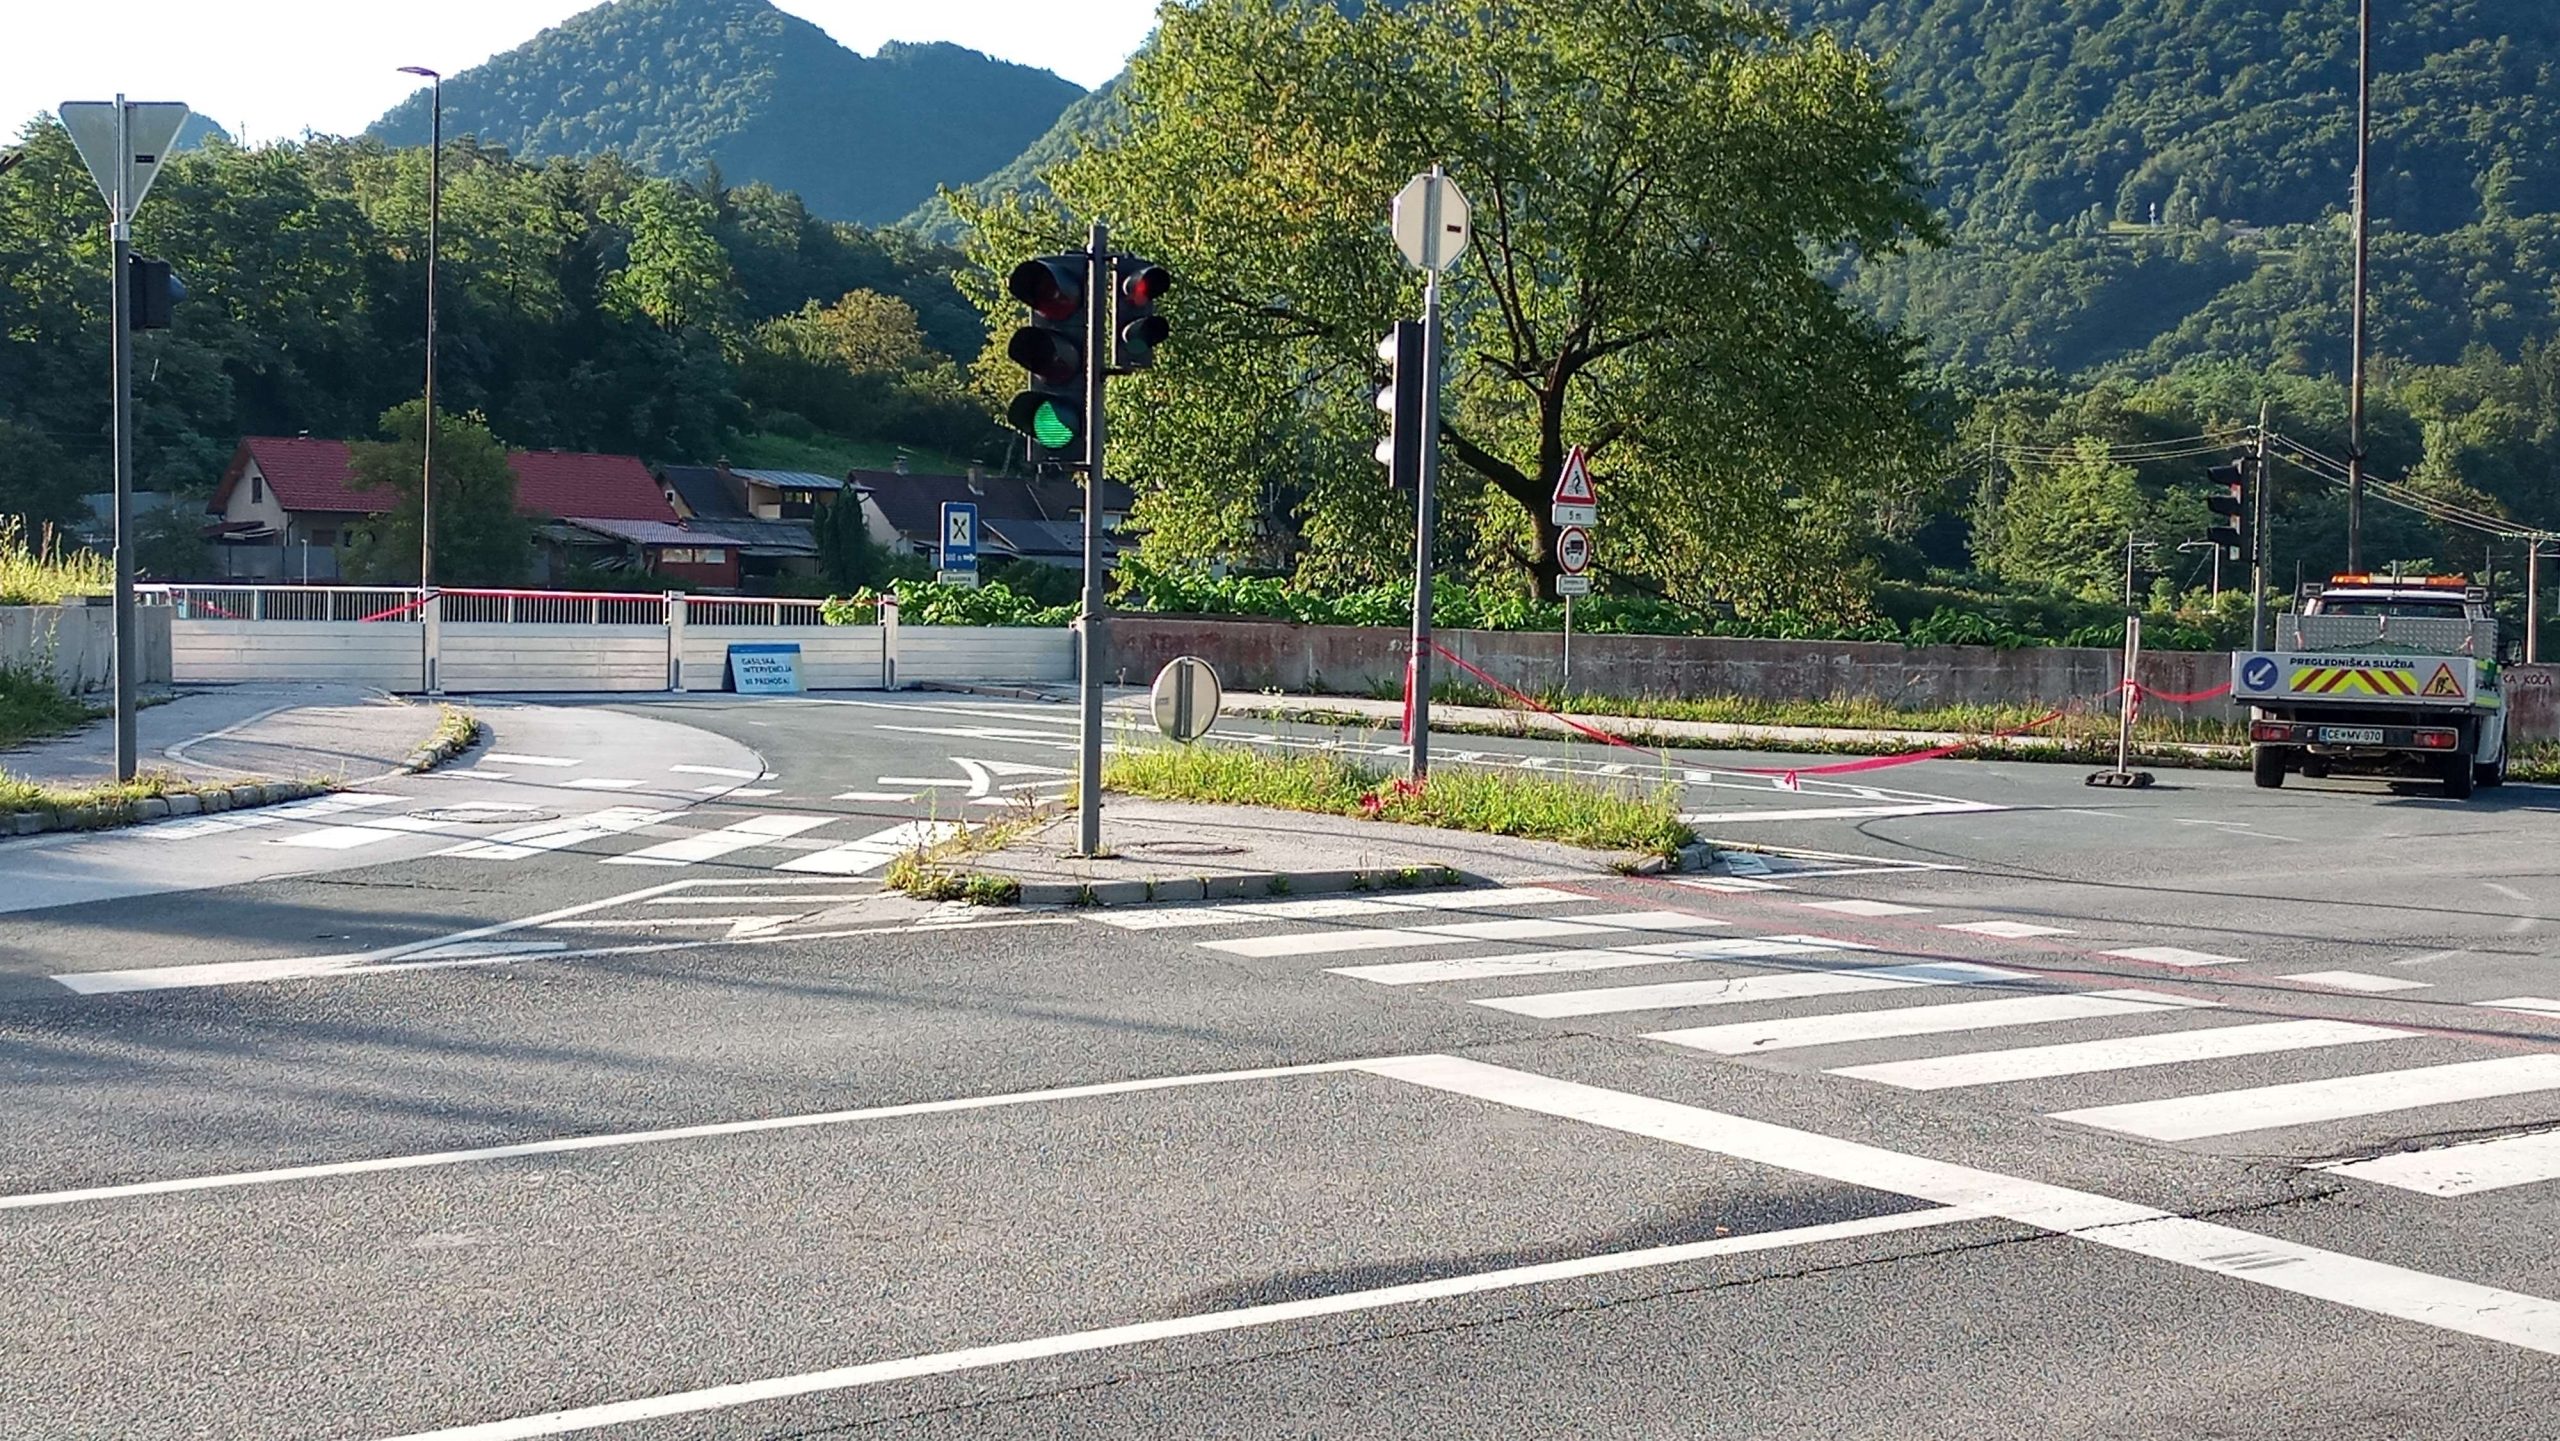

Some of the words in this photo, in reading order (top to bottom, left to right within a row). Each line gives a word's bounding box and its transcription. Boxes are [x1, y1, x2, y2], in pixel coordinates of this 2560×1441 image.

[1569, 510, 1574, 520] 5
[1575, 512, 1582, 520] m
[2289, 657, 2370, 667] PREGLEDNIŠKA
[2372, 659, 2415, 668] SLUŽBA
[2523, 672, 2552, 686] KOČA
[2327, 729, 2340, 739] CE
